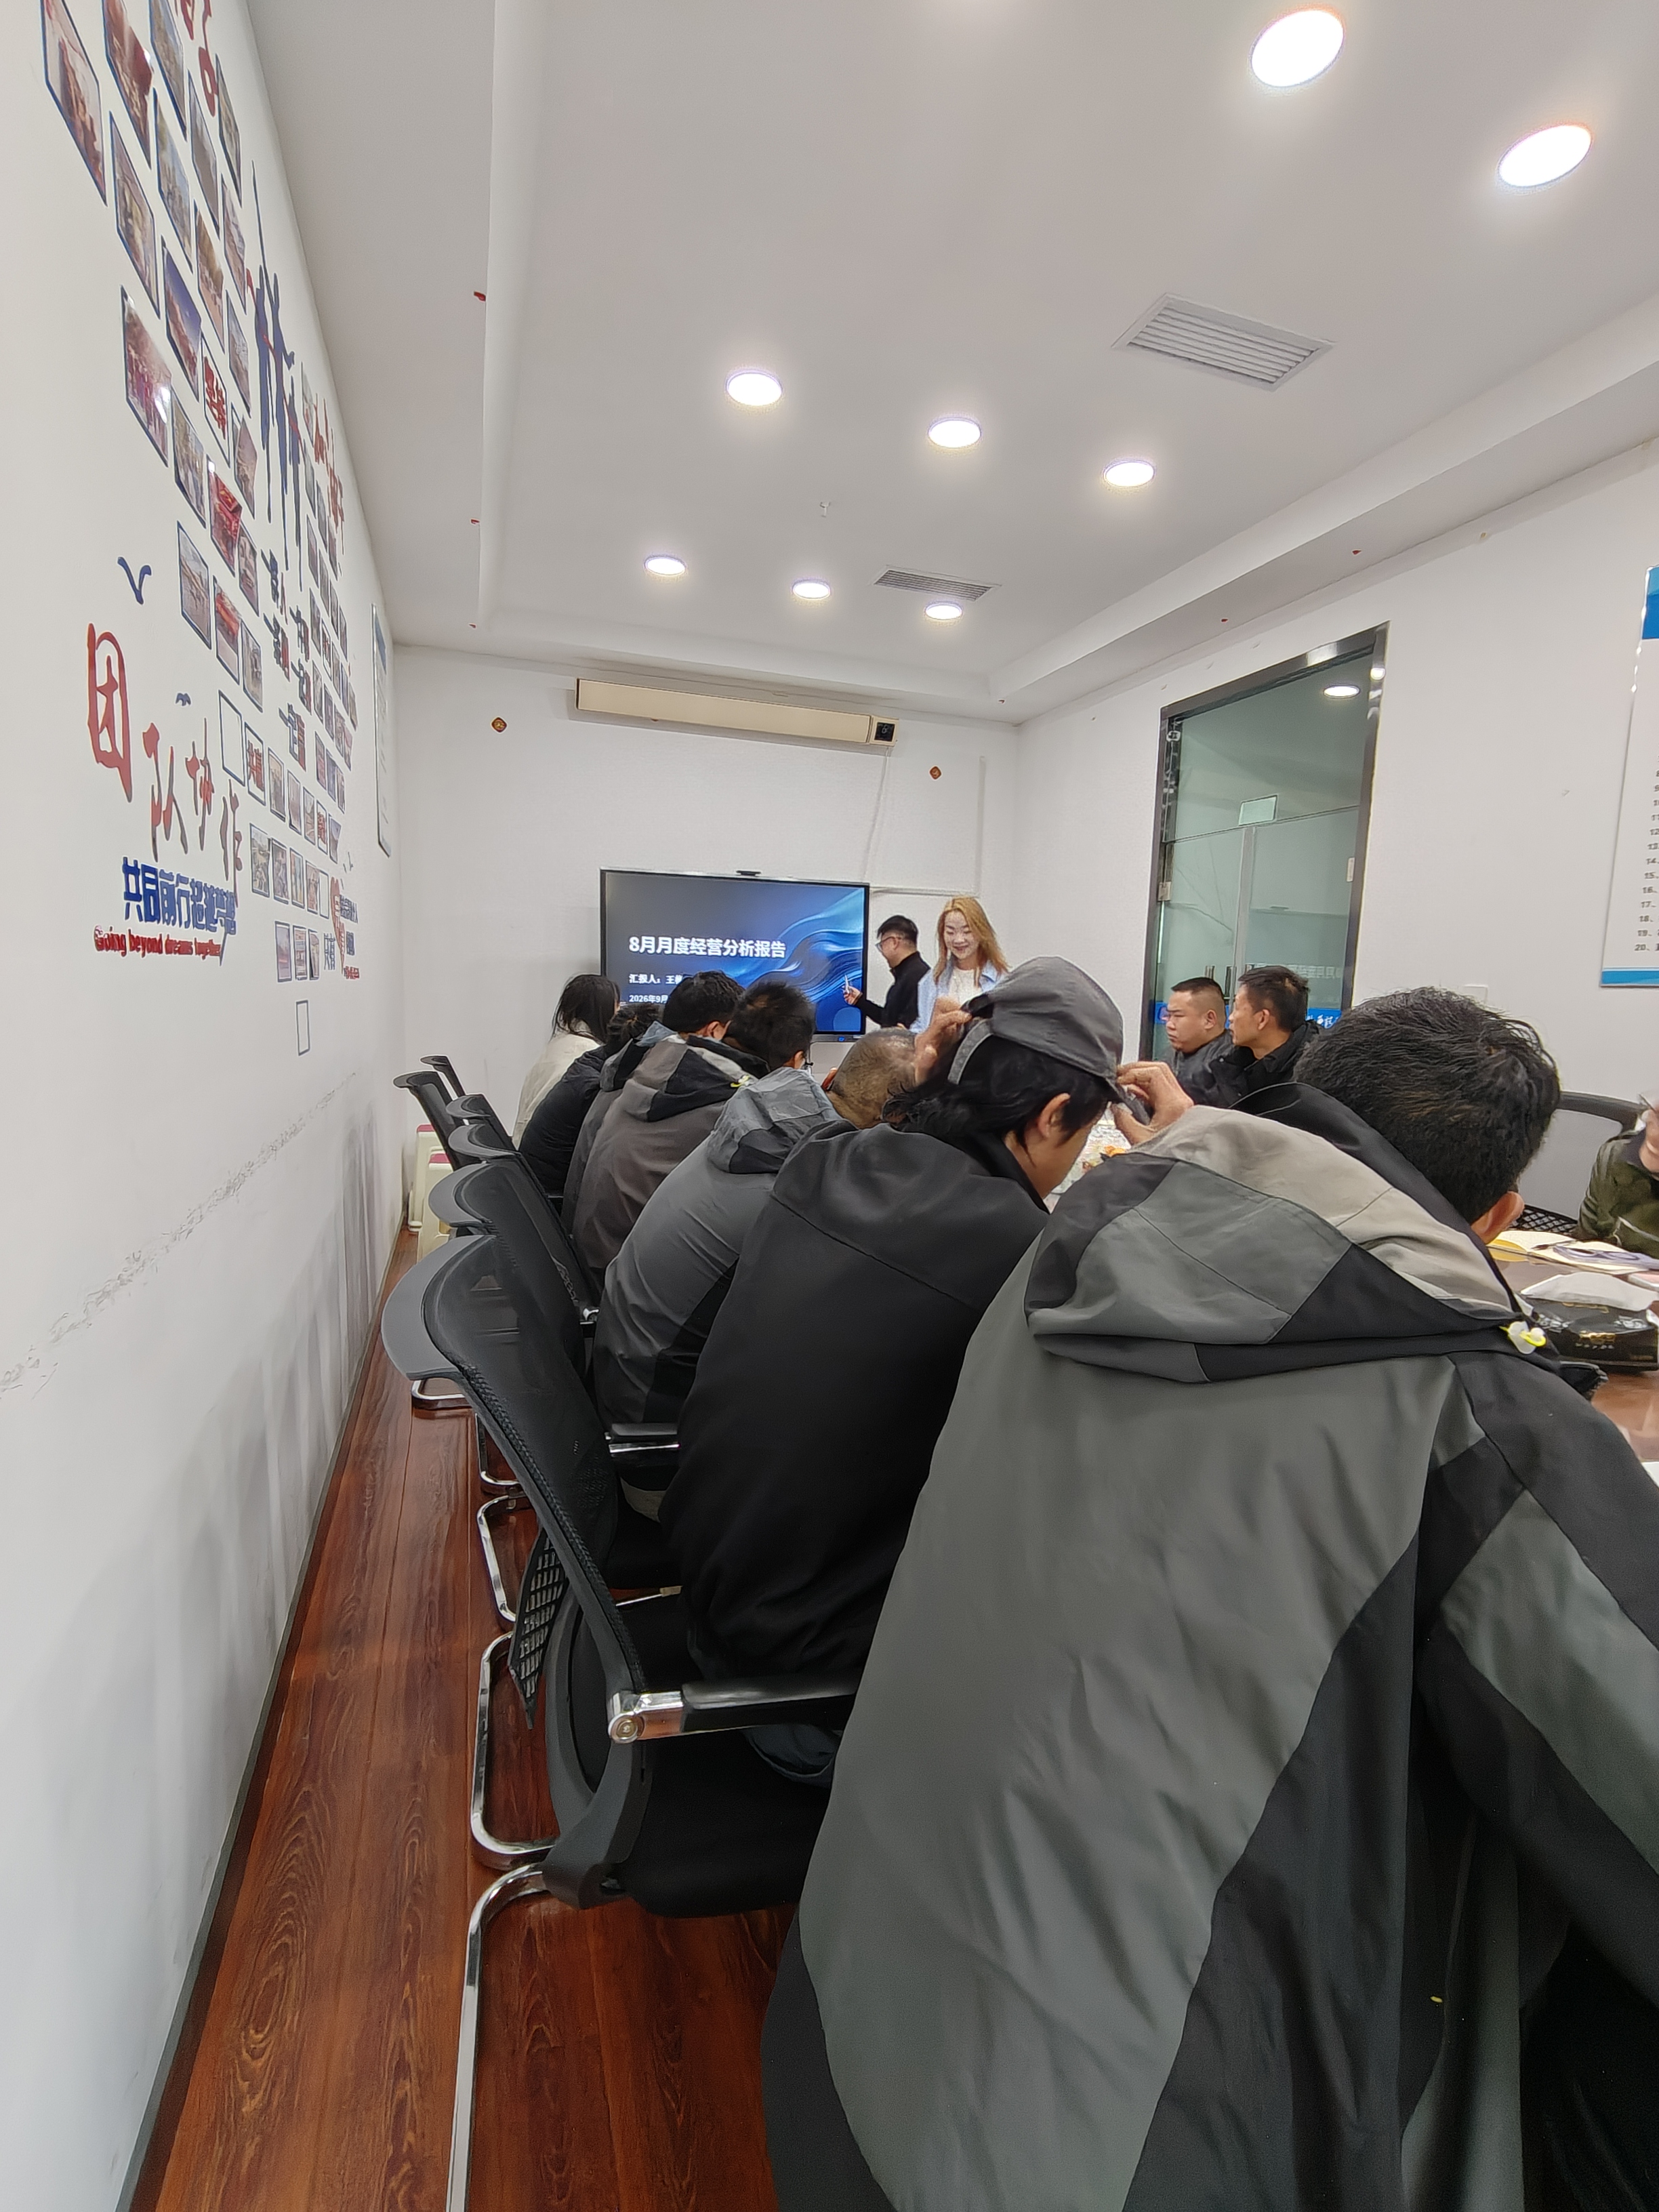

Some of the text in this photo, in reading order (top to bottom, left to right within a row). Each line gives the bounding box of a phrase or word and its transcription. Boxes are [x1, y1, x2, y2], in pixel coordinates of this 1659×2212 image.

[629, 936, 786, 958] 8月月度经营分析报告
